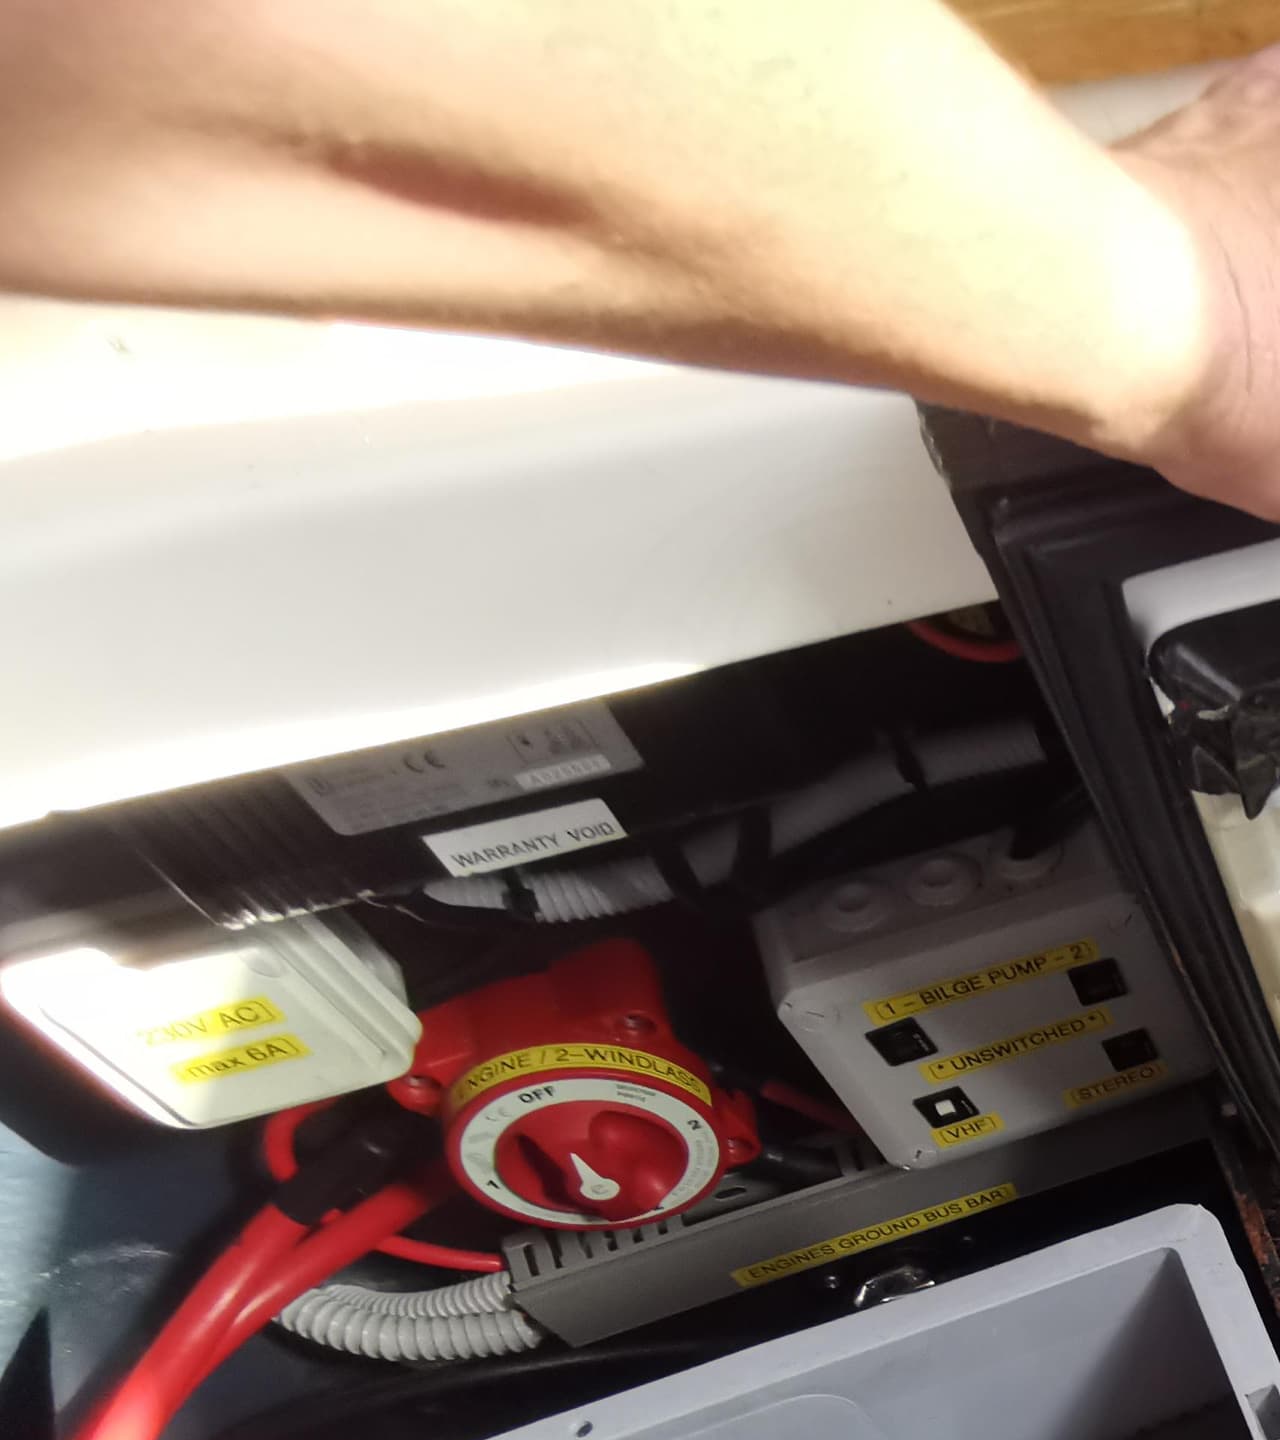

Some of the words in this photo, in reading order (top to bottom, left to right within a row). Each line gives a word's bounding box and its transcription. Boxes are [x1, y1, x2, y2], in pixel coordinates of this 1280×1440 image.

[451, 833, 561, 868] WARRANTY
[566, 821, 616, 845] VOID
[919, 976, 986, 1005] BILGE
[989, 957, 1050, 985] PUMP
[1070, 945, 1085, 960] 2
[218, 1006, 260, 1028] AC
[187, 1056, 247, 1078] max
[246, 1043, 289, 1061] 6A
[952, 1018, 1087, 1071] UNSWITCHED
[518, 1086, 557, 1104] OFF
[1079, 1067, 1156, 1101] STEREO
[687, 1119, 702, 1131] 2
[945, 1118, 992, 1139] VHF
[749, 1244, 836, 1280] ENGINES
[837, 1216, 921, 1250] GROUND
[924, 1202, 963, 1223] BUS
[965, 1189, 1005, 1210] BAR
